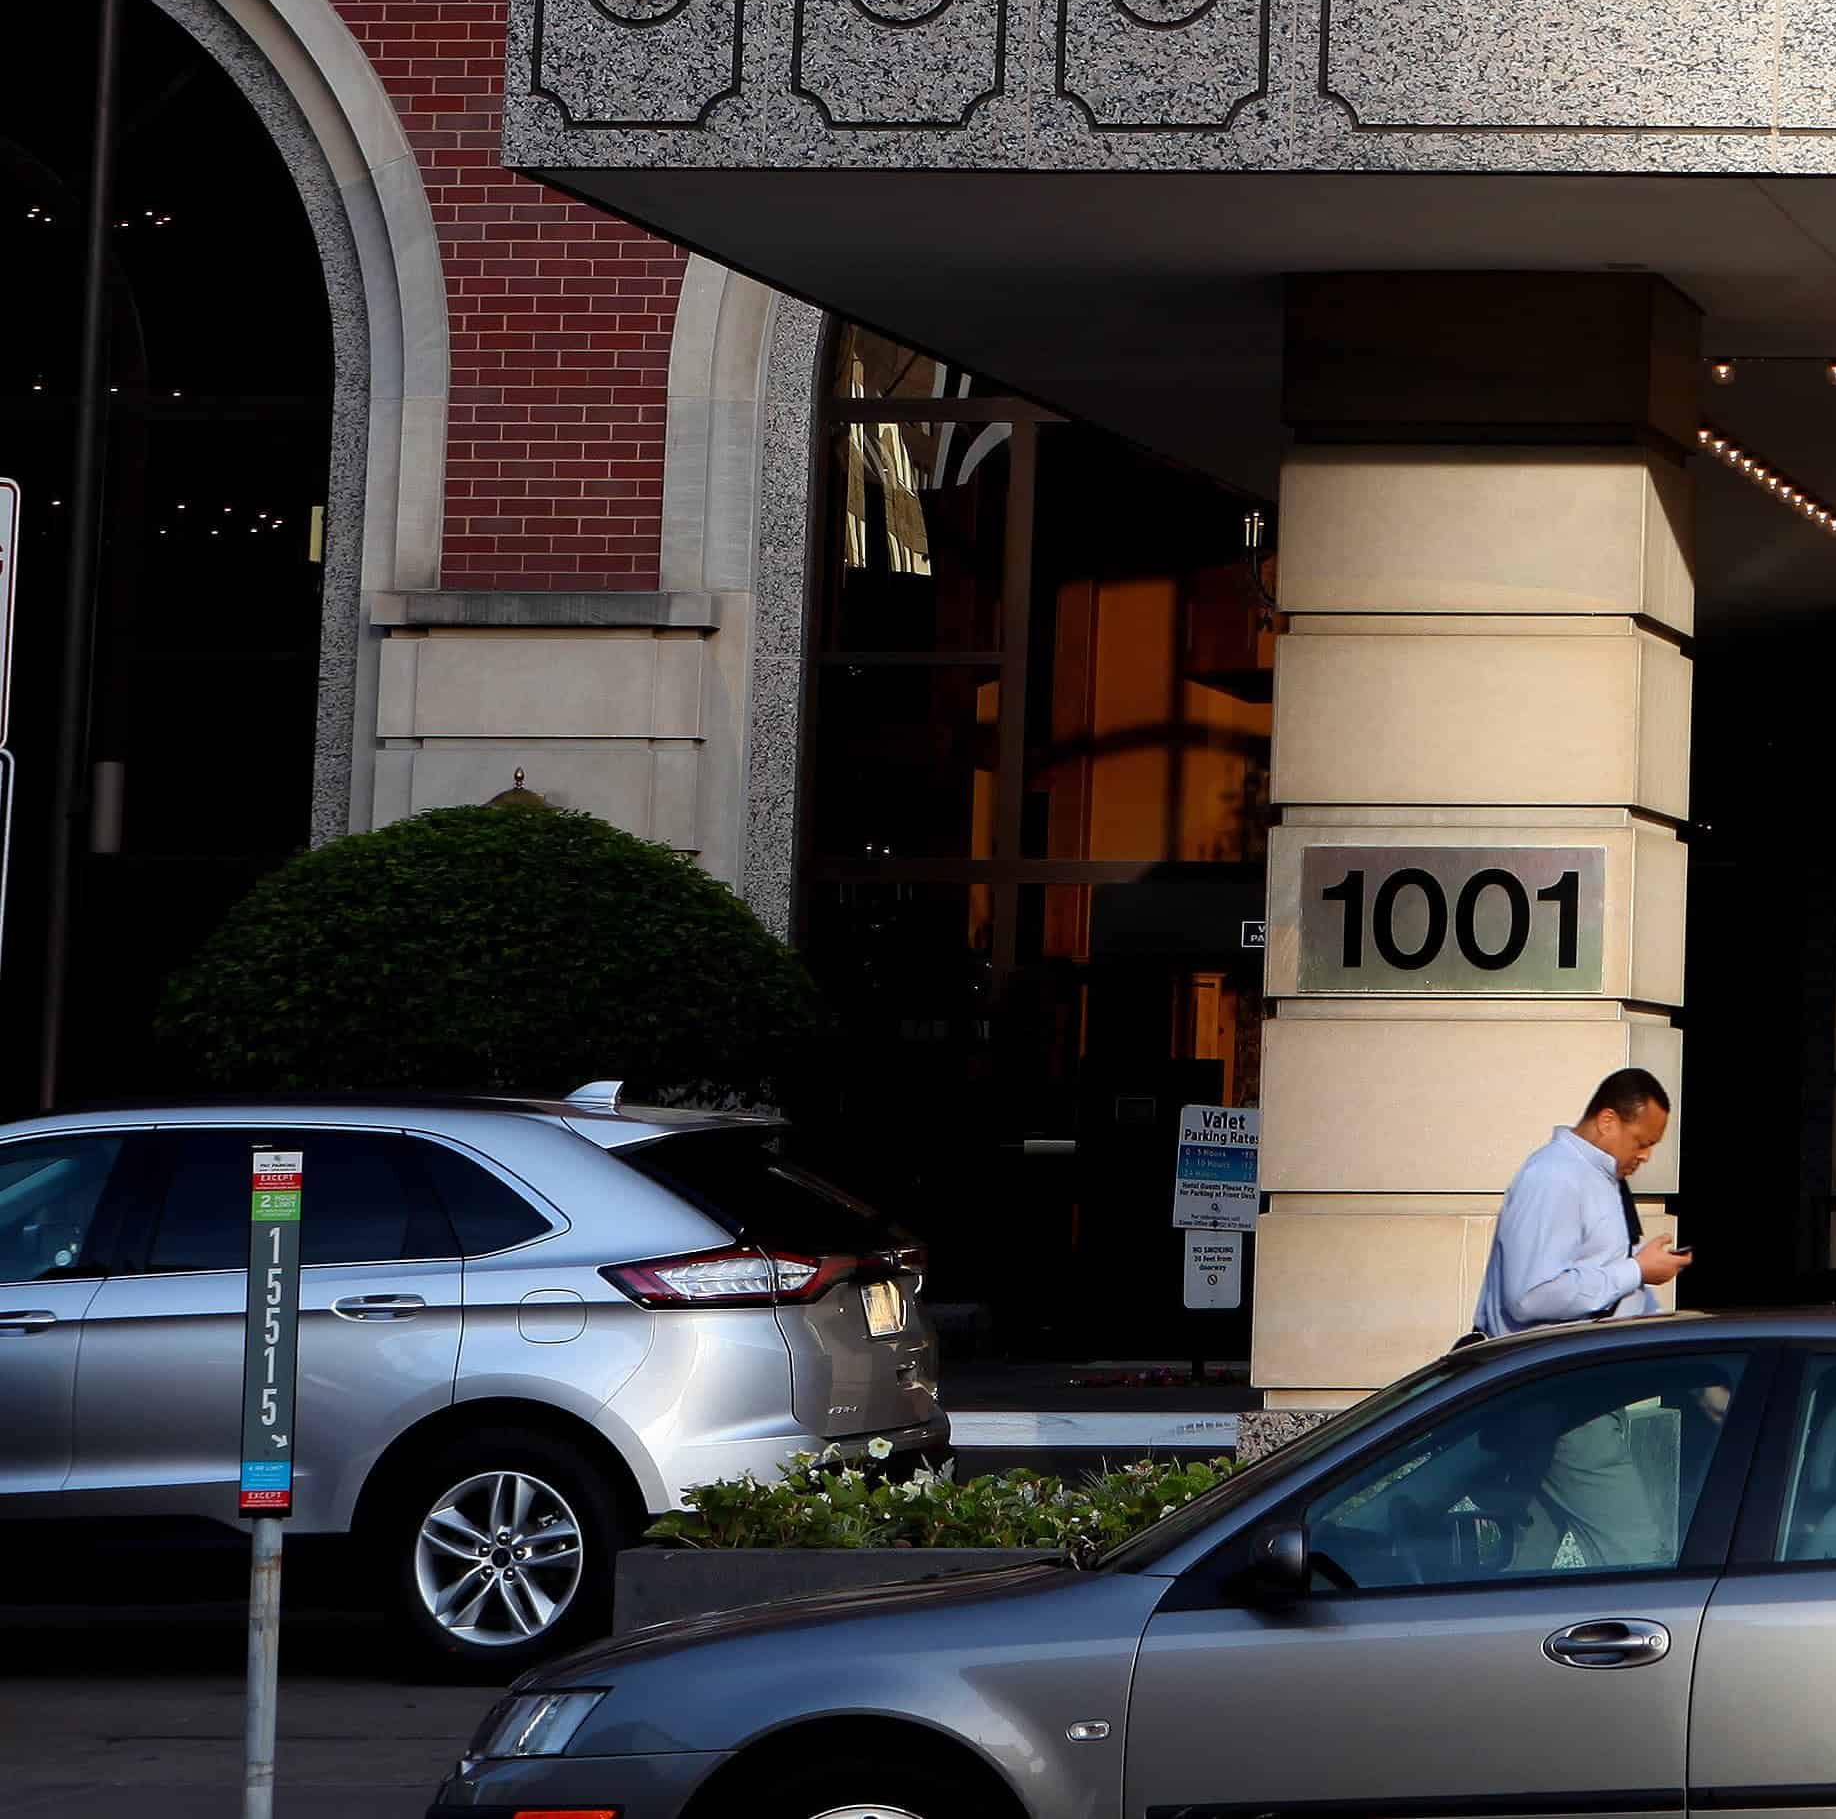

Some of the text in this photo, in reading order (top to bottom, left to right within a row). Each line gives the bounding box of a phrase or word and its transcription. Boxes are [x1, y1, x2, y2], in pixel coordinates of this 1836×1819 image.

[1322, 867, 1580, 971] 1001
[1202, 1111, 1246, 1130] Valet
[1184, 1129, 1227, 1146] Parking
[260, 1194, 272, 1208] 2
[261, 1227, 283, 1426] 15515
